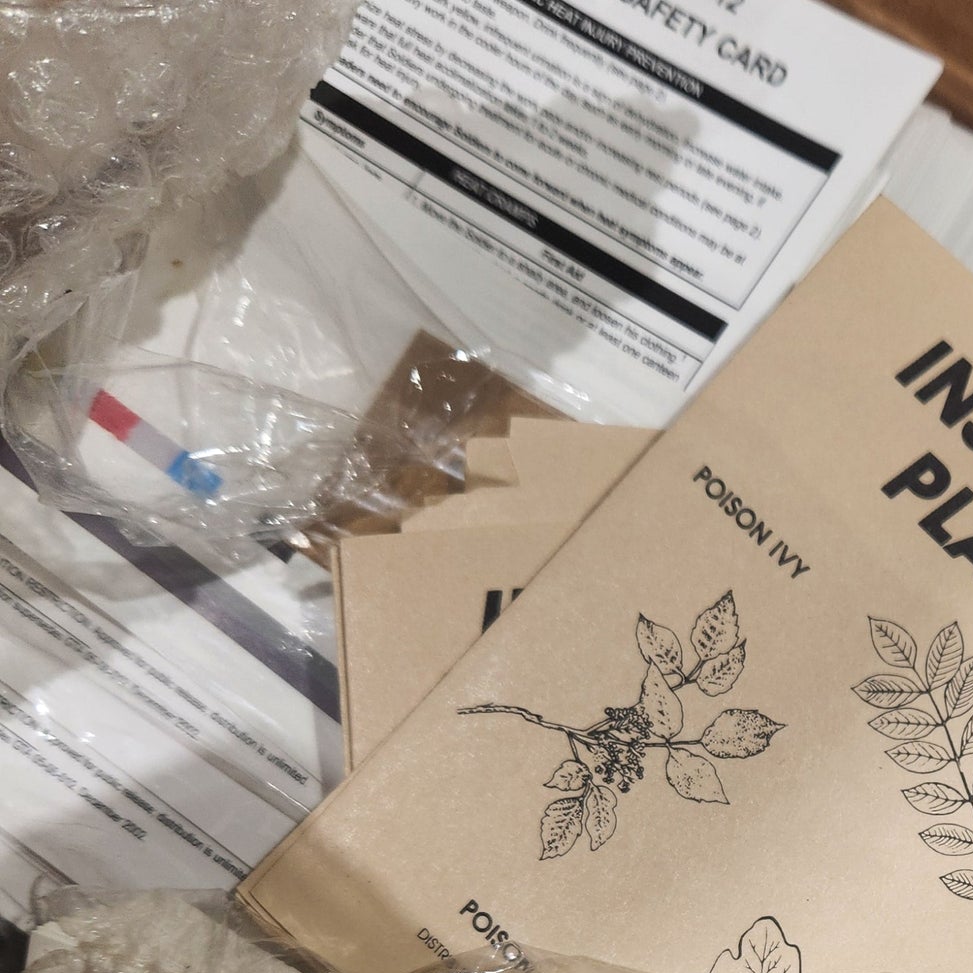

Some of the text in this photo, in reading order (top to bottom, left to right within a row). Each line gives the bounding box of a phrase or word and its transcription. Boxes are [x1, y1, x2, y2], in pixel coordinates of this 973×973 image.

[622, 0, 788, 85] AFETY CARD
[692, 465, 811, 579] POISON IVY
